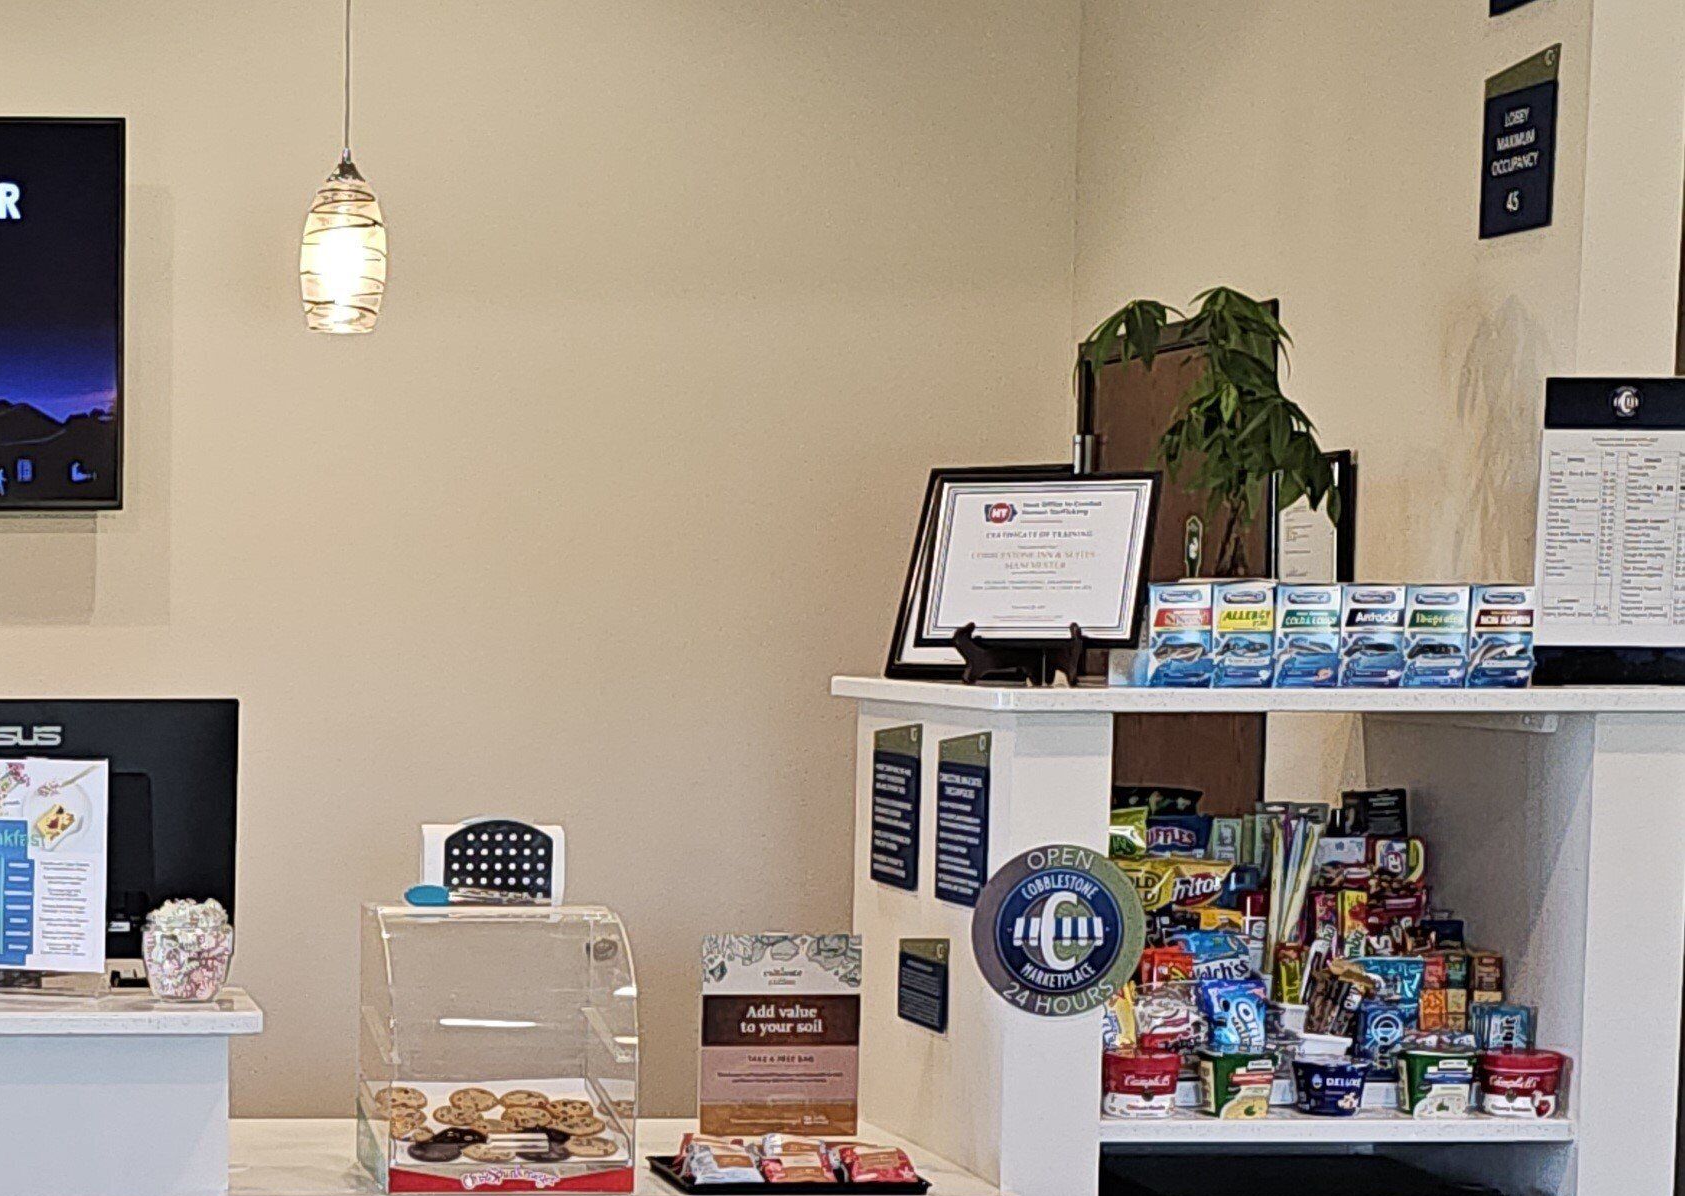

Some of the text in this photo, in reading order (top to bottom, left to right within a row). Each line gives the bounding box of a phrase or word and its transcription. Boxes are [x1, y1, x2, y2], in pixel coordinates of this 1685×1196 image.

[1504, 107, 1530, 127] LOBBY
[1496, 129, 1536, 151] MAXIMUM
[1490, 151, 1539, 177] OCCUPANCY
[1027, 848, 1094, 870] OPEN
[1021, 874, 1100, 900] COBBLESTONE
[1020, 962, 1097, 988] MARKETPLACE
[1003, 979, 1114, 1014] 24 HOURS
[746, 1004, 818, 1019] Add value
[740, 1019, 823, 1037] to your soil
